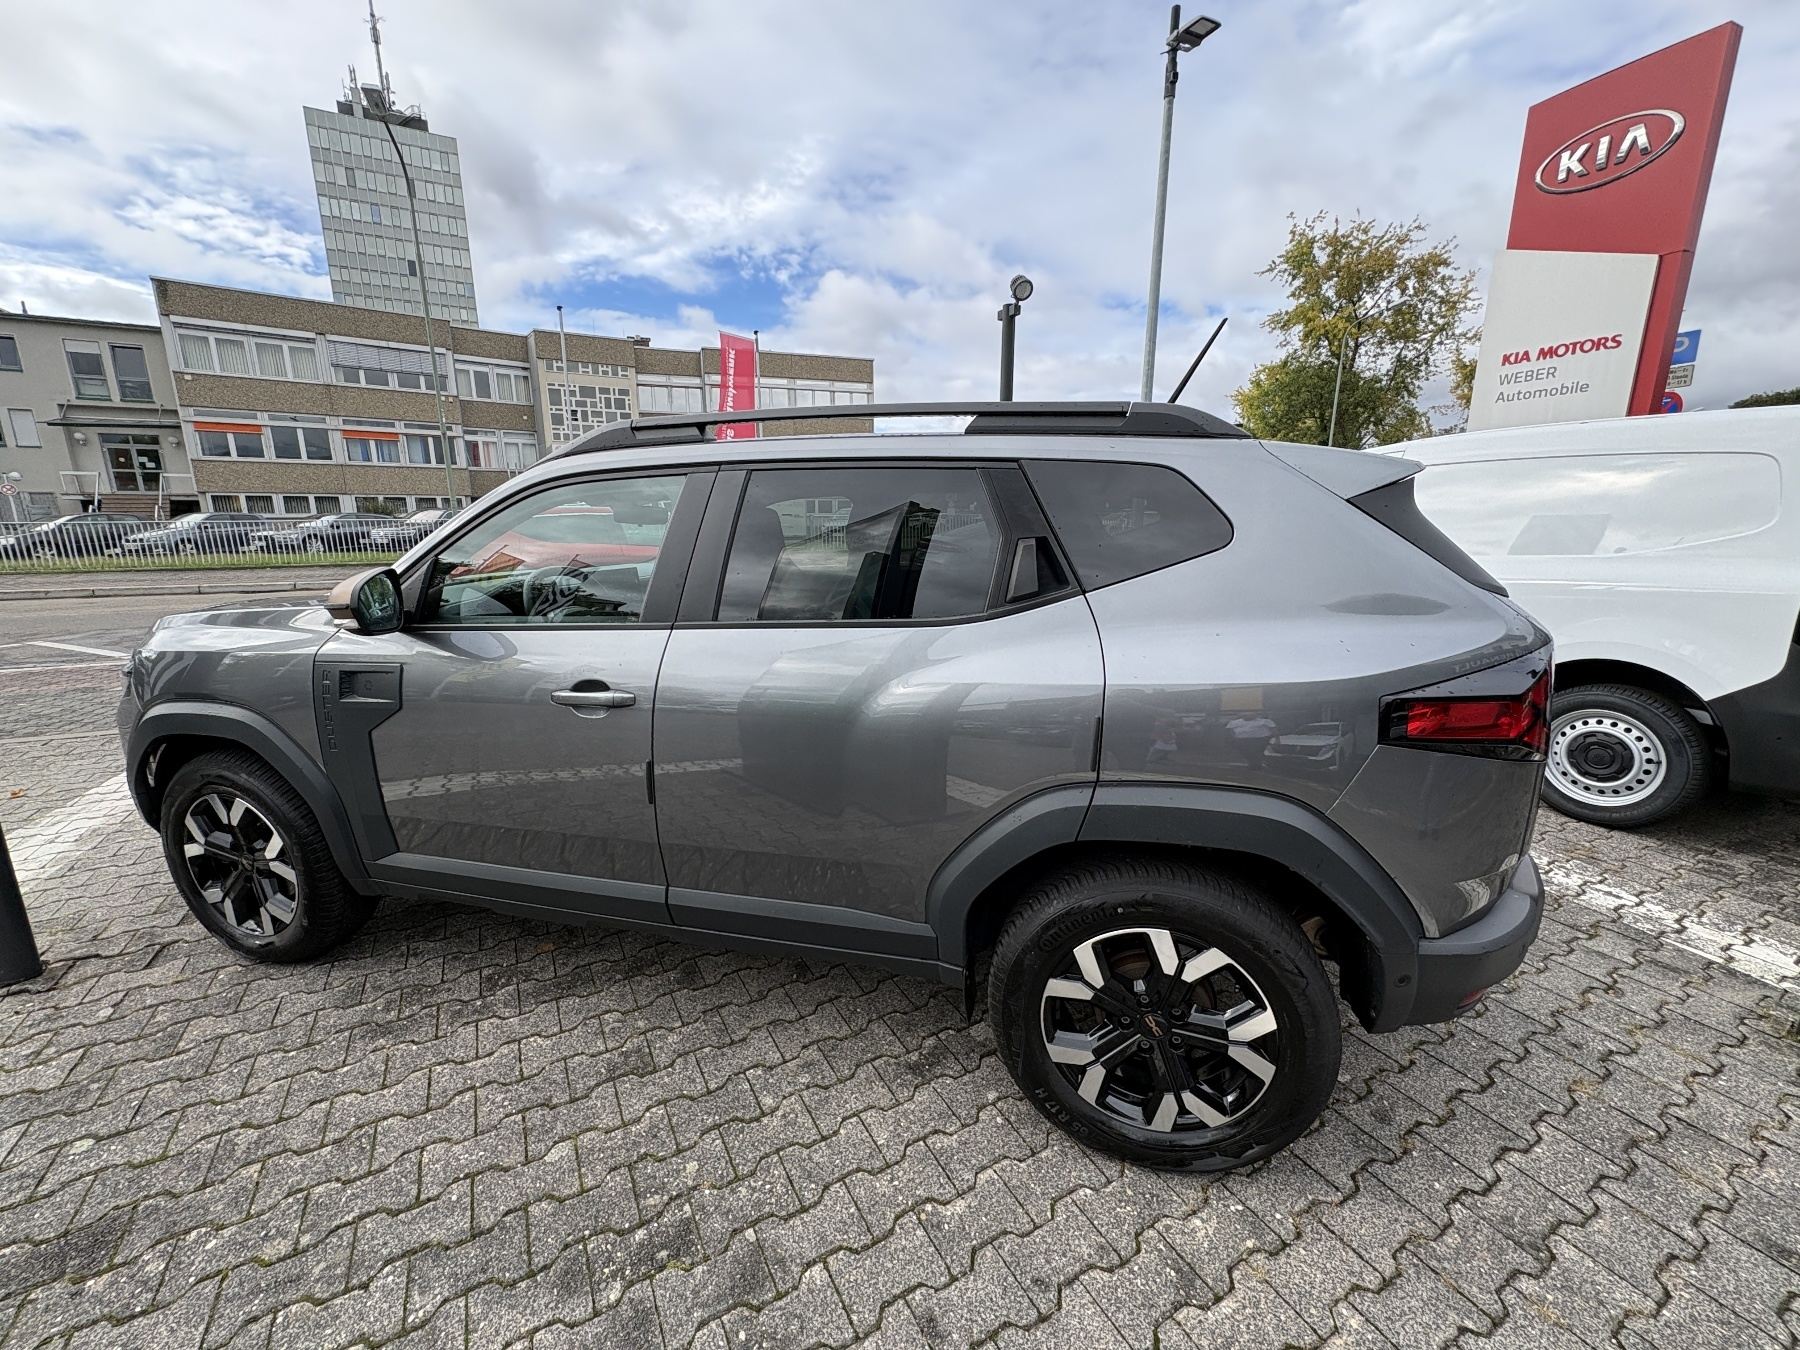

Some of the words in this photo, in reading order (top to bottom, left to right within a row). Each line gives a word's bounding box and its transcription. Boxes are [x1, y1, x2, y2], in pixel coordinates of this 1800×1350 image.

[1557, 123, 1652, 183] KIA
[1501, 350, 1531, 366] KIA
[1536, 334, 1622, 361] MOTORS
[1499, 366, 1557, 386] WEBER
[1495, 381, 1590, 403] Automobile
[322, 670, 339, 752] DUSTER
[1034, 1087, 1048, 1098] H
[1044, 1101, 1071, 1122] R17
